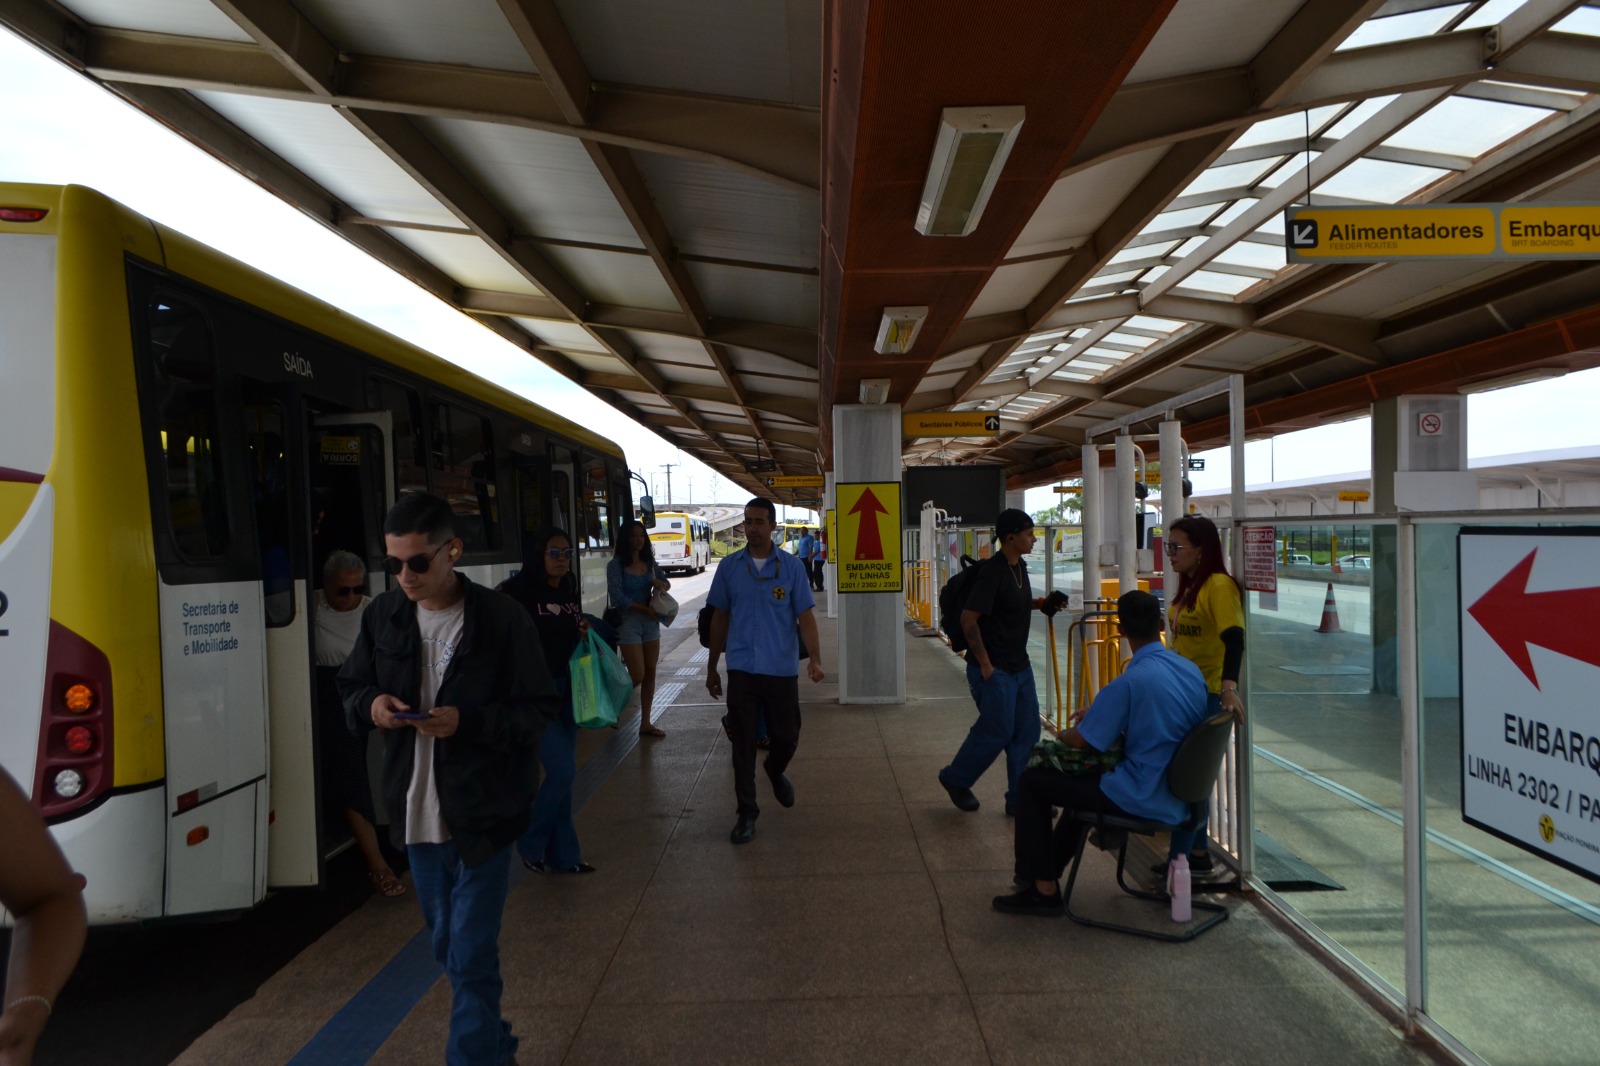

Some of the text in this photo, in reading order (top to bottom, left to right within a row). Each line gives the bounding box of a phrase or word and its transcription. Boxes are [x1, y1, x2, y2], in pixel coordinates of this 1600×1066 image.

[1328, 222, 1484, 241] Alimentadores
[1329, 241, 1398, 251] FEEDER ROUTES
[1511, 239, 1574, 247] BRT BOARDING
[283, 351, 314, 380] SAÍDA
[846, 563, 893, 571] EMBARQUE
[182, 600, 239, 617] Secretaria de
[182, 619, 231, 637] Transporte
[184, 636, 239, 656] e Mobilidade
[1504, 712, 1600, 778] EMBARQ
[1468, 754, 1513, 792] LINHA
[1517, 772, 1560, 810] 2302
[1565, 789, 1573, 814] /
